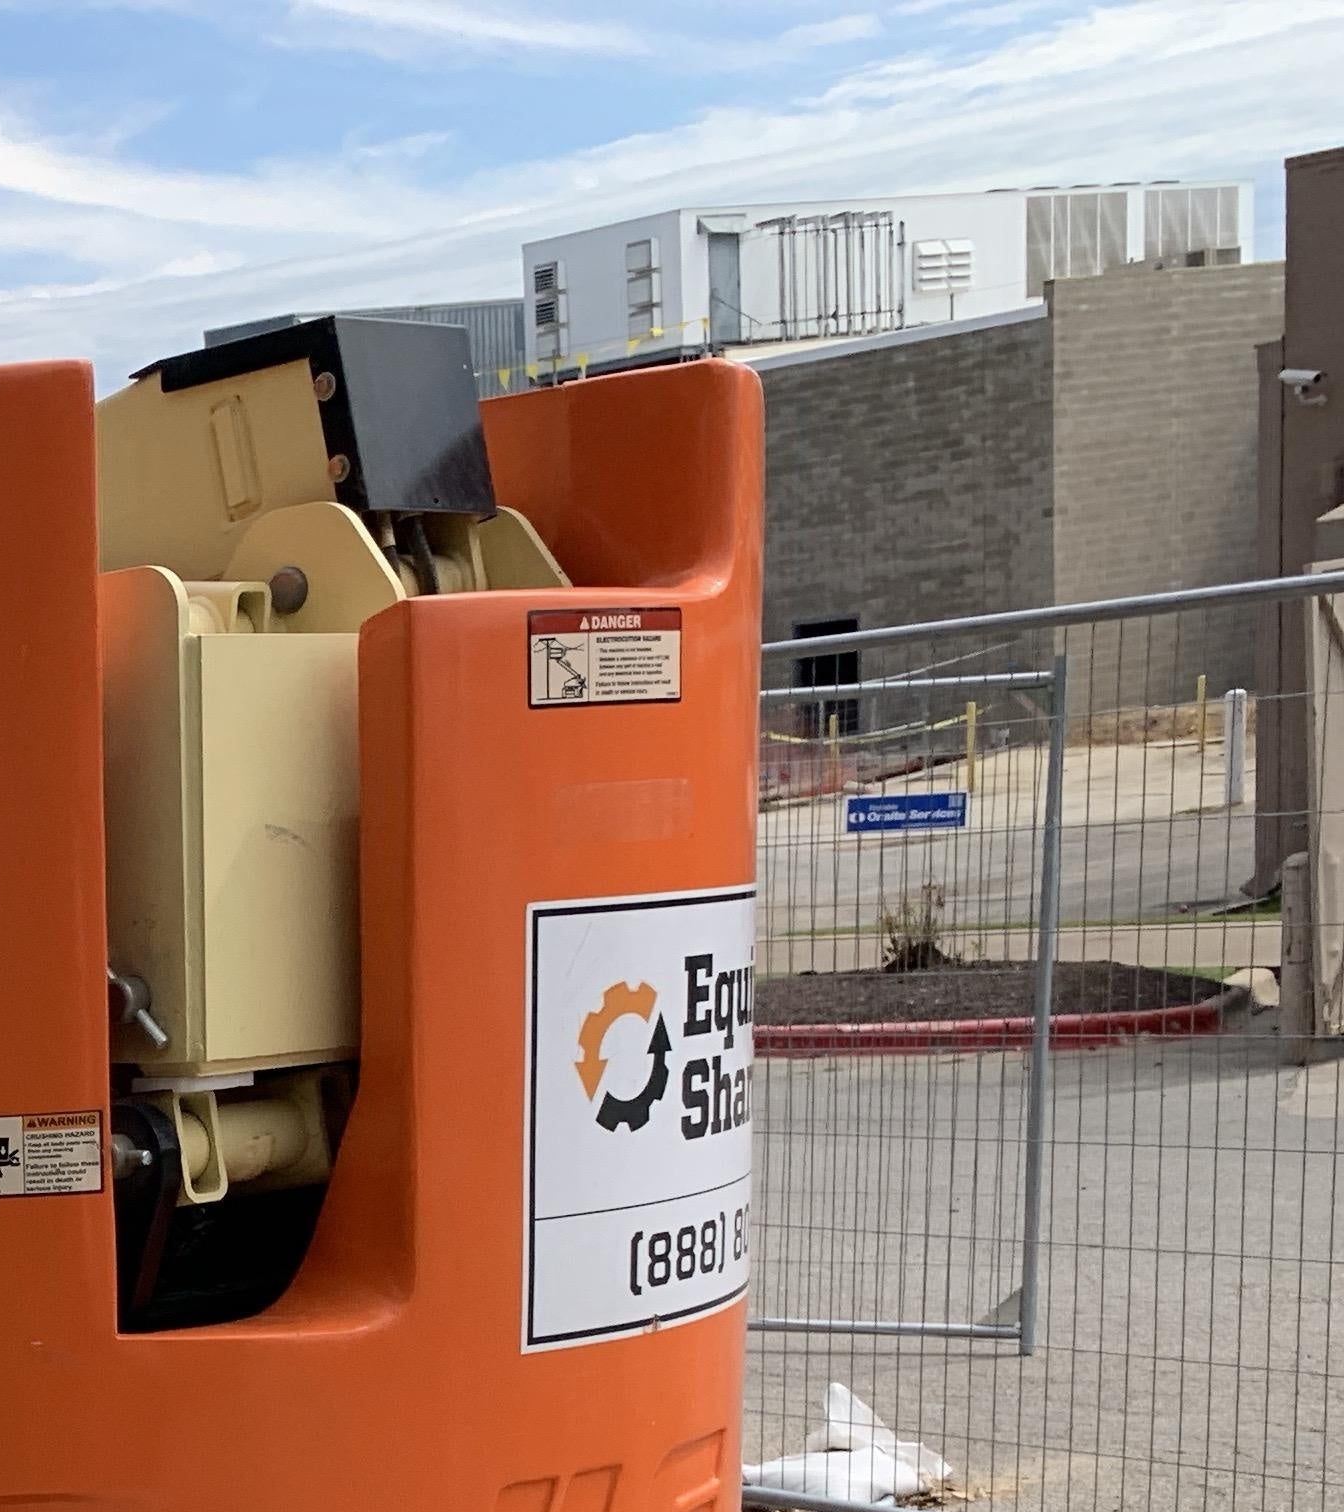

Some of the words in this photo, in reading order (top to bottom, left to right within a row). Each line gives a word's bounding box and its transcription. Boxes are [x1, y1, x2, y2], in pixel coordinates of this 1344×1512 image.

[591, 615, 641, 629] DANGER
[37, 1115, 96, 1128] WARNING
[26, 1132, 63, 1140] CRUSHING
[64, 1130, 95, 1138] HAZARD
[629, 1220, 725, 1296] (888)
